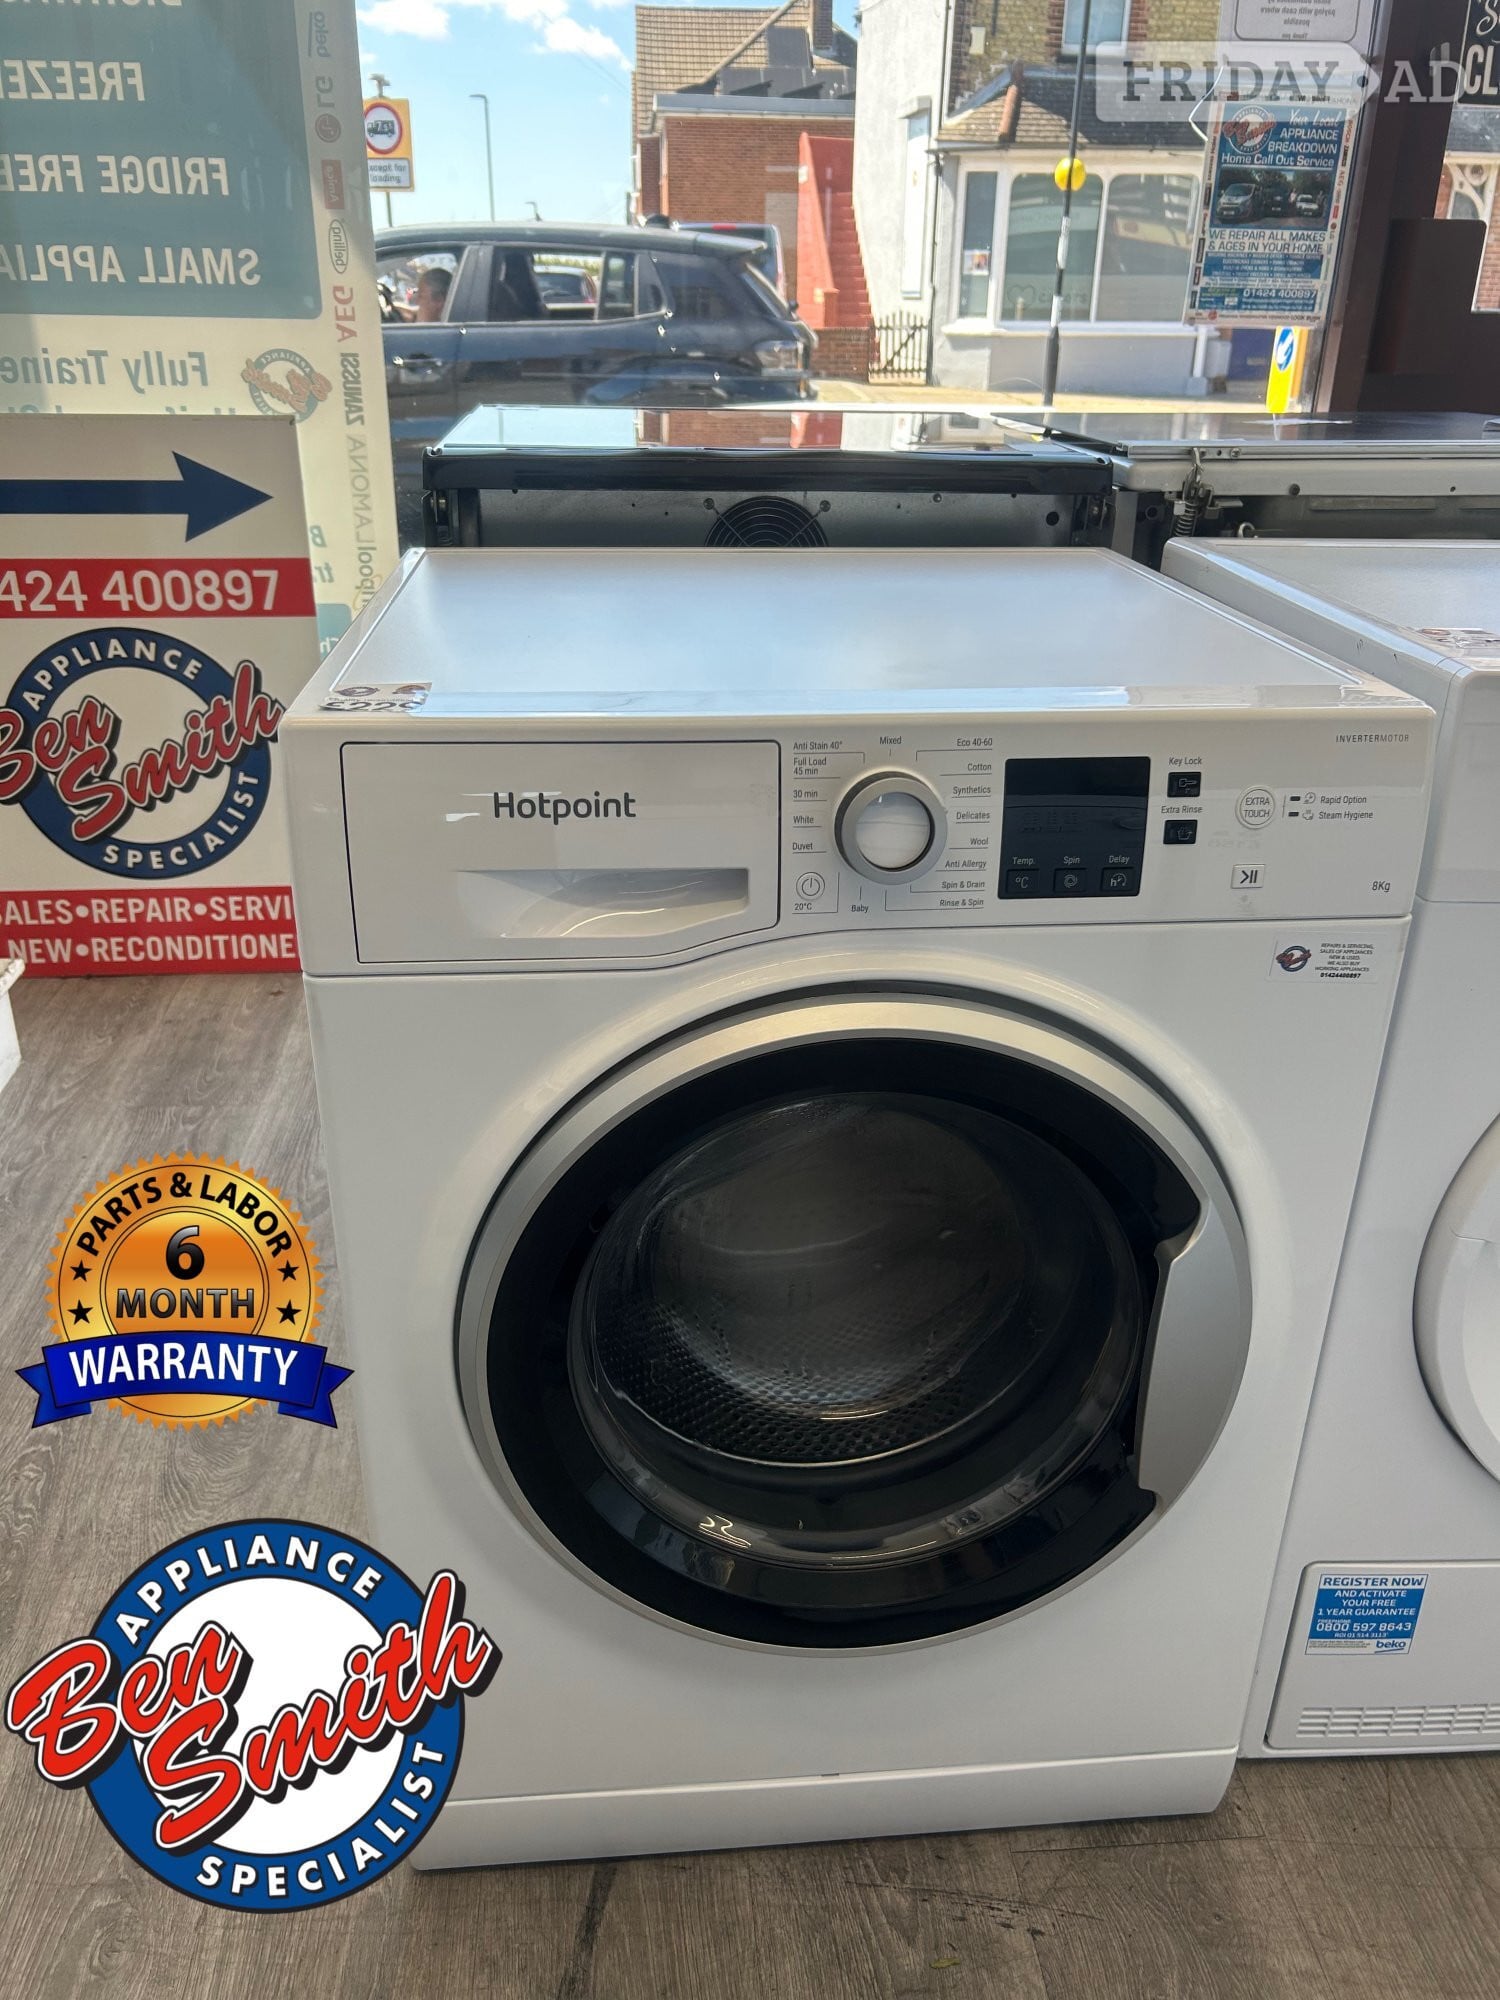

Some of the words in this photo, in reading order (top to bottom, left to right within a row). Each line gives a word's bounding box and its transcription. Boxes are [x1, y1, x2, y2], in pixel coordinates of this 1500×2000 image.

[1289, 109, 1308, 126] Your
[1312, 109, 1342, 127] Local
[1280, 128, 1339, 141] APPLIANCE
[1268, 141, 1337, 154] BREAKDOWN
[1222, 152, 1251, 164] Home
[1254, 153, 1273, 165] Call
[1275, 154, 1294, 165] Out
[1297, 155, 1334, 167] Service
[368, 165, 391, 174] xcept
[1209, 229, 1226, 240] WE
[1228, 230, 1266, 240] REPAIR
[1267, 231, 1287, 241] ALL
[1289, 231, 1326, 242] MAKES
[1208, 241, 1215, 250] &
[1218, 241, 1246, 251] AGES
[1248, 241, 1259, 251] IN
[1262, 241, 1290, 252] YOUR
[1292, 242, 1323, 253] HOME
[1243, 288, 1276, 298] 01424
[102, 569, 279, 612] 400897
[22, 638, 203, 712] APPLIANCE
[793, 741, 808, 750] Anti
[810, 741, 828, 750] Stain
[879, 736, 902, 745] Mixed
[956, 738, 970, 747] Eco
[972, 737, 993, 747] 40-60
[0, 697, 115, 801] Ben
[57, 662, 284, 840] Smith
[793, 757, 806, 766] Full
[808, 757, 827, 766] Load
[1169, 757, 1183, 766] Key
[1185, 756, 1202, 765] Lock
[793, 766, 802, 775] 45
[803, 766, 818, 775] min
[967, 762, 992, 772] Cotton
[793, 789, 802, 798] 30
[803, 789, 818, 798] min
[953, 785, 991, 797] Synthetics
[1245, 797, 1270, 806] EXTRA
[1320, 795, 1341, 805] Rapid
[1342, 795, 1367, 805] Option
[493, 790, 636, 825] Hotpoint
[1161, 805, 1180, 814] Extra
[1181, 805, 1203, 814] Rinse
[956, 810, 990, 821] Delicates
[1244, 809, 1270, 818] TOUCH
[1318, 810, 1342, 820] Steam
[1344, 810, 1373, 821] Hygiene
[103, 771, 259, 870] SPECIALIST
[793, 815, 814, 824] White
[792, 842, 813, 851] Duvet
[970, 837, 989, 846] Wool
[1013, 856, 1035, 866] Temp.
[1063, 855, 1081, 866] Spin
[1109, 854, 1130, 866] Delay
[945, 859, 960, 869] Anti
[962, 859, 987, 872] Allergy
[942, 880, 957, 891] Spin
[959, 881, 965, 890] &
[966, 880, 985, 890] Drain
[1372, 880, 1391, 893] 8Kg
[794, 902, 812, 911] 20°C
[939, 898, 958, 908] Rinse
[960, 899, 966, 908] &
[967, 898, 984, 908] Spin
[0, 899, 73, 926] ALES
[851, 903, 869, 914] Baby
[1323, 1577, 1388, 1586] REGISTER
[1391, 1577, 1424, 1586] NOW
[1326, 1608, 1353, 1616] YEAR
[1355, 1608, 1416, 1616] GUARANTEE
[1316, 1623, 1349, 1631] 0800
[1352, 1623, 1378, 1631] 597
[1379, 1622, 1411, 1631] 8643
[1376, 1640, 1406, 1649] beko
